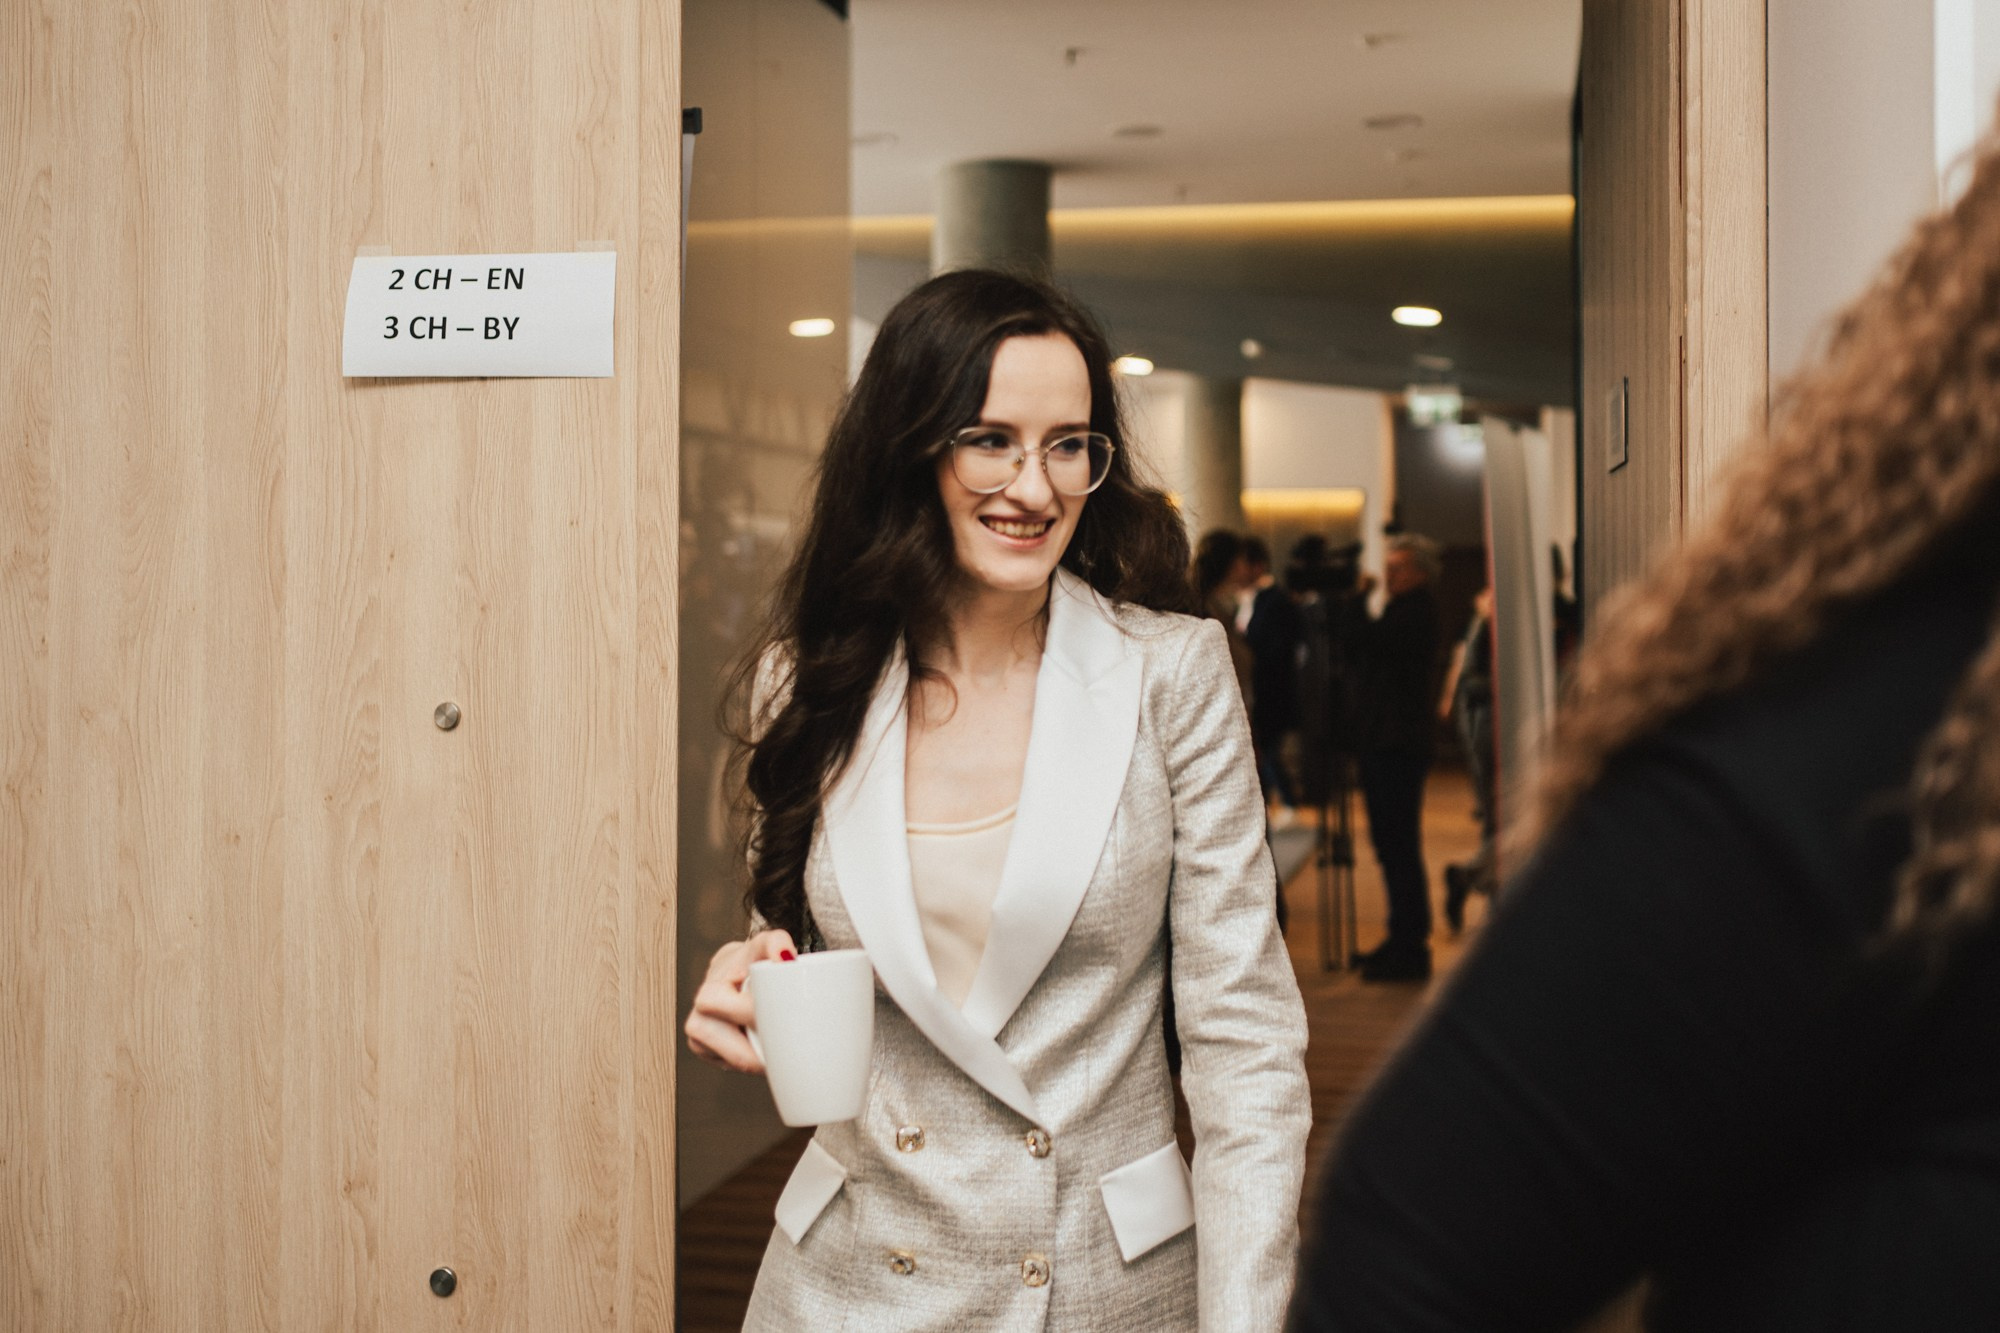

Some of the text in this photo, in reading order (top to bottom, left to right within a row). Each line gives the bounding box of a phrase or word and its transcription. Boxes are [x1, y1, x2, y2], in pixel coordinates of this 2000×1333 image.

[388, 269, 405, 290] 2
[414, 268, 452, 290] CH
[487, 267, 525, 290] EN
[383, 315, 399, 340] 3
[409, 316, 447, 340] CH
[483, 316, 520, 340] BY
